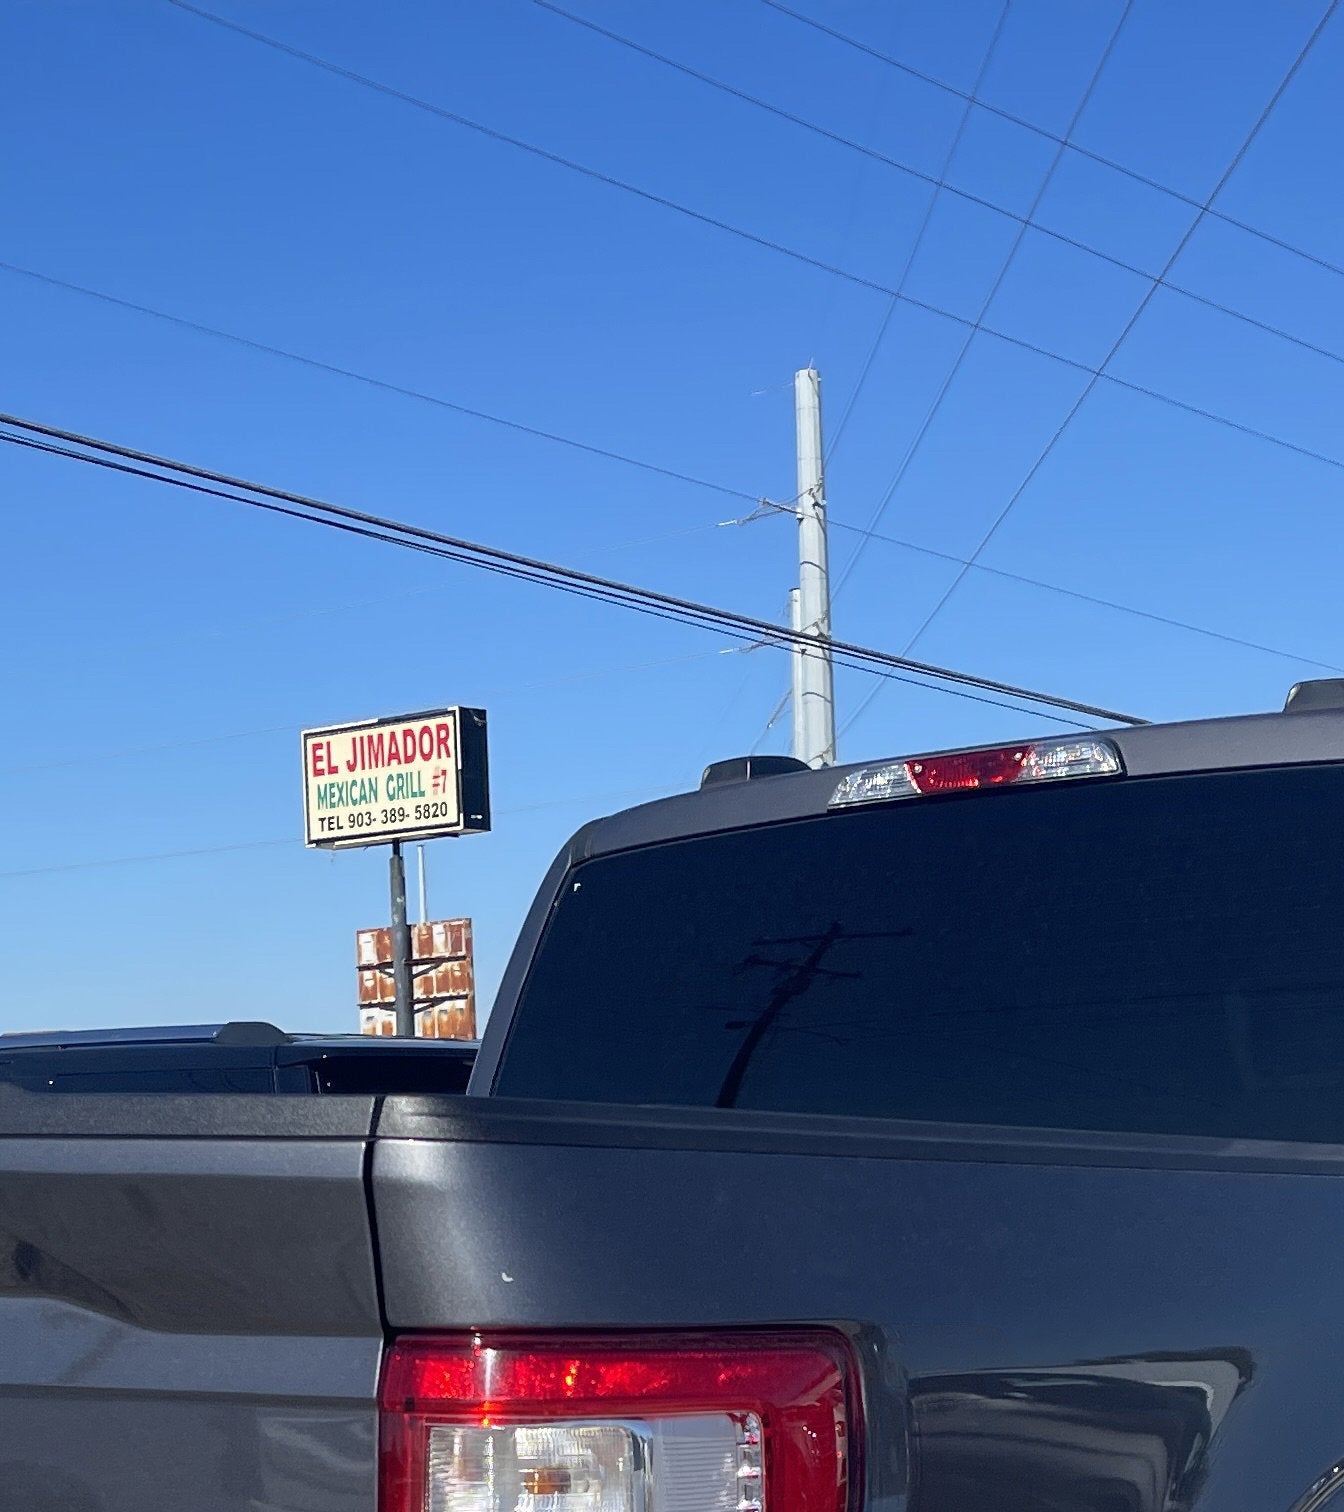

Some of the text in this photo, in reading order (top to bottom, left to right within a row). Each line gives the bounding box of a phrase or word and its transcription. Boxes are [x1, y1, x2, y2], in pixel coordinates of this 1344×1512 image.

[312, 722, 452, 777] EL JIMADOR
[317, 777, 378, 810] MEXICAN
[386, 770, 426, 802] GRILL
[318, 816, 344, 832] TEL
